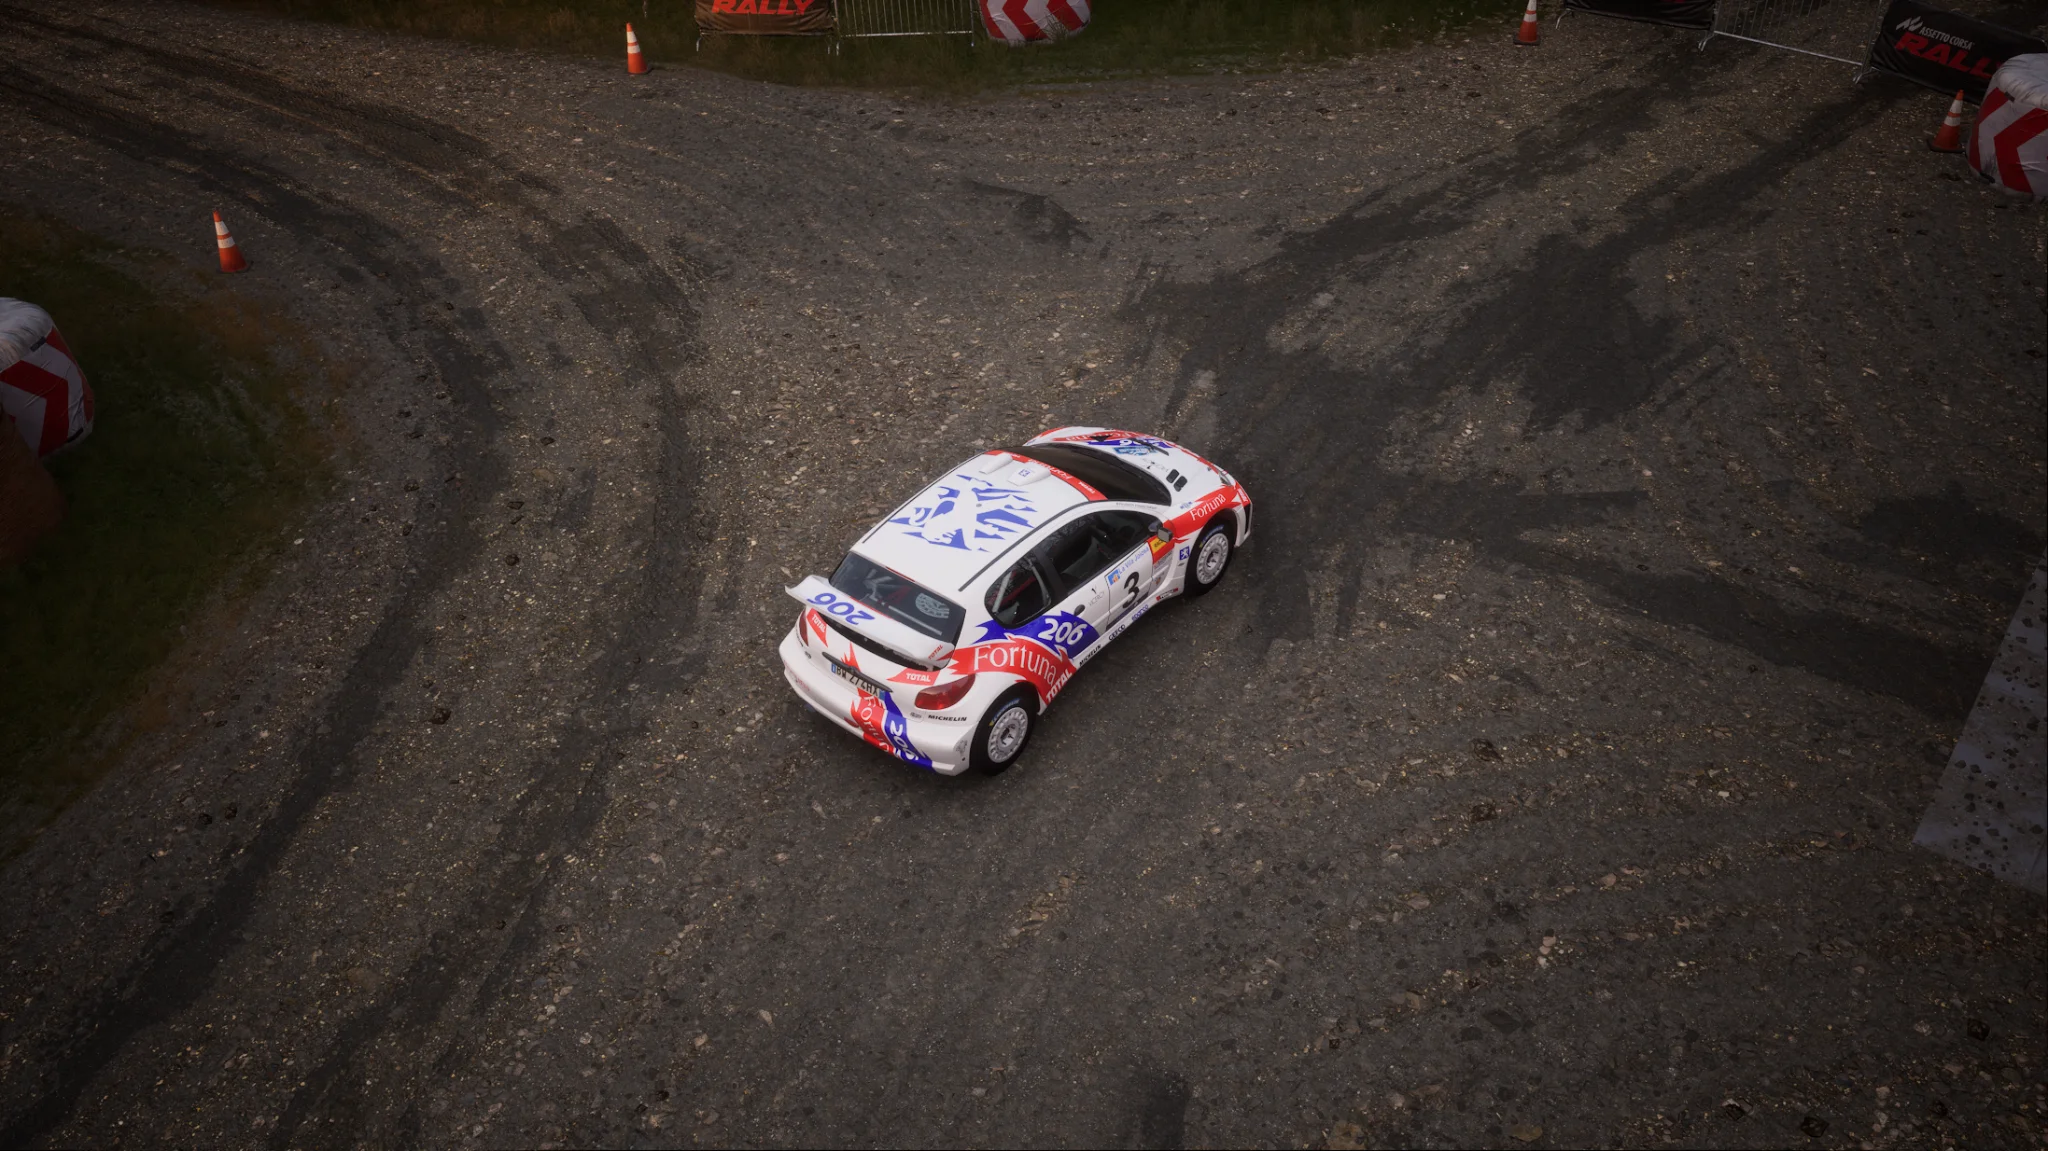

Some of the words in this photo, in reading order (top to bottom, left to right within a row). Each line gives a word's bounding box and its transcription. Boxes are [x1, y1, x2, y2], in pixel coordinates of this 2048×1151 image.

[1919, 26, 1950, 42] ASSETTO
[1949, 36, 1973, 50] CORSA
[1895, 31, 2002, 79] RALL
[1189, 494, 1226, 521] Fortuna
[1122, 571, 1140, 609] 3
[806, 592, 876, 625] 206
[811, 613, 826, 633] TOTAL
[1038, 618, 1088, 645] 206
[1109, 624, 1126, 641] GEFCO
[973, 644, 1057, 686] Fortuna
[1079, 644, 1102, 667] MICHELIN
[905, 672, 931, 683] TOTAL
[1046, 668, 1073, 703] TOTAL
[928, 714, 967, 722] MICHELIN
